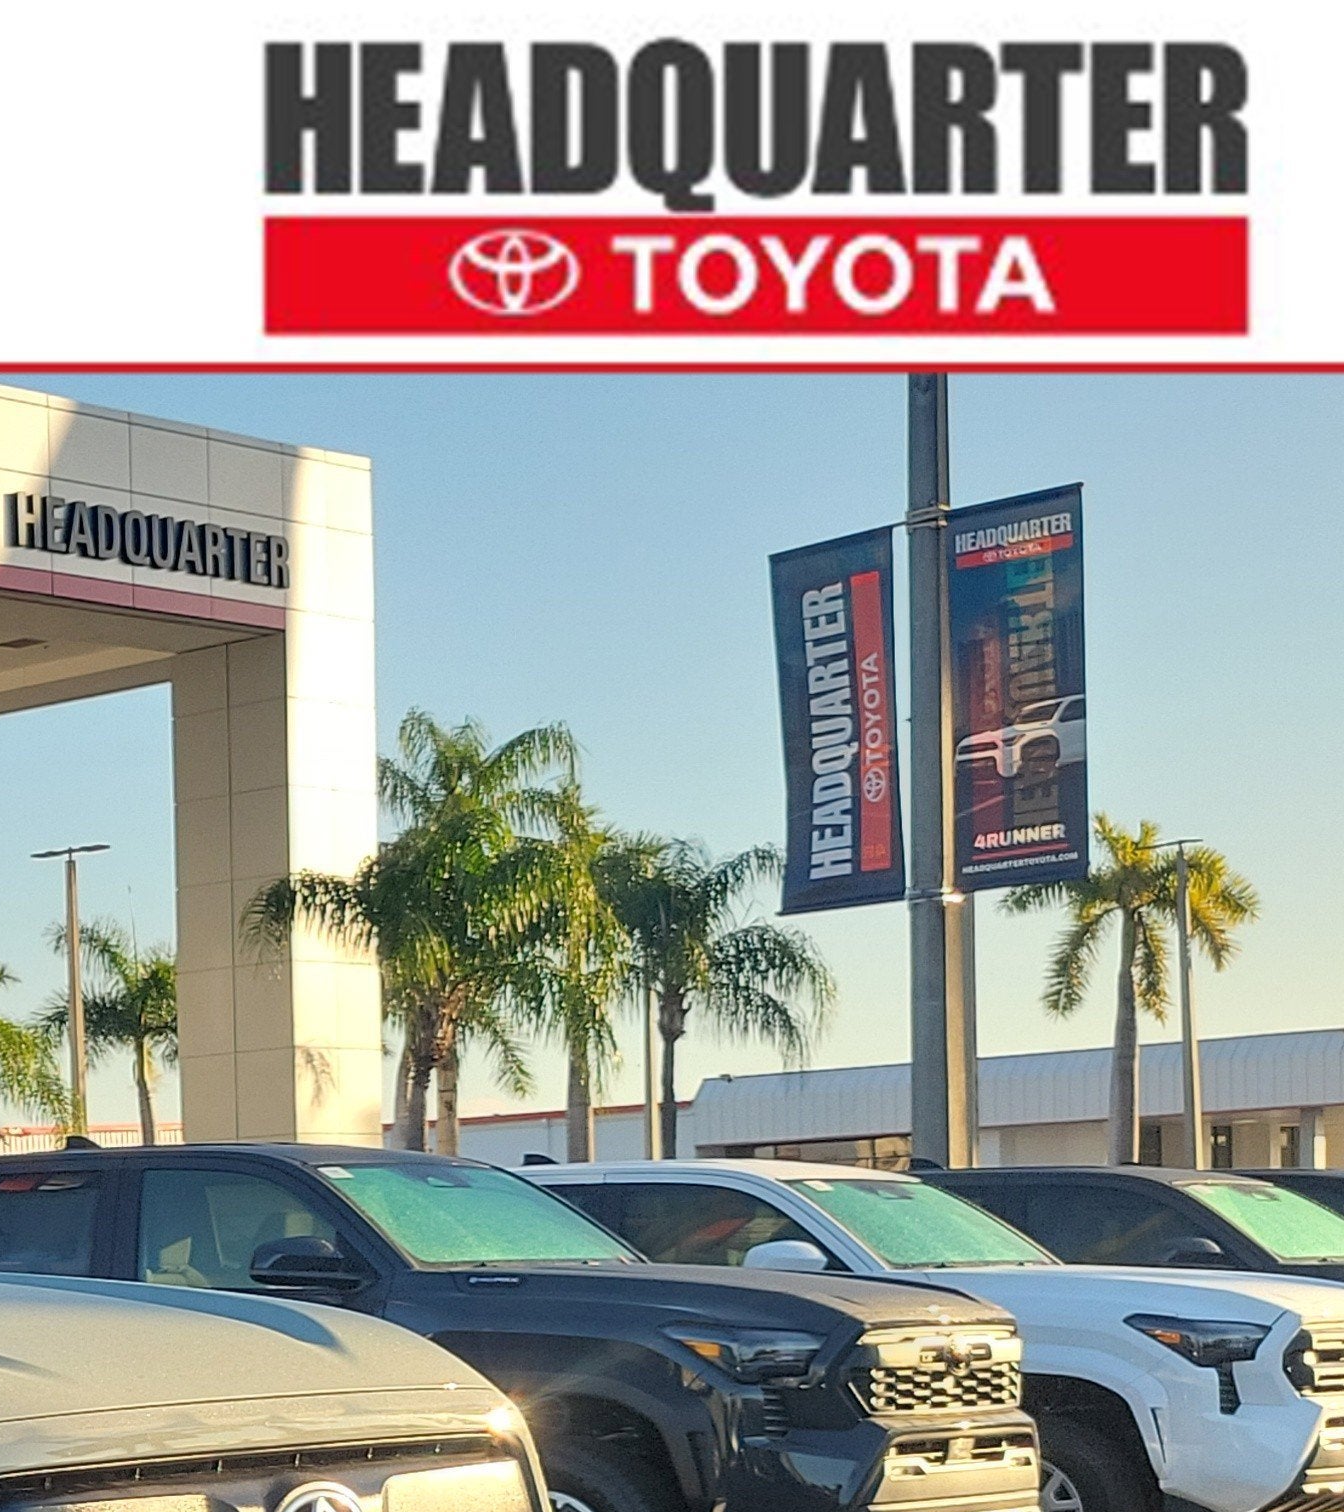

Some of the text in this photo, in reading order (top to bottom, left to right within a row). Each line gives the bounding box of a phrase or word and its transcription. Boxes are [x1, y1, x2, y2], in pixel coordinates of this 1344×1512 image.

[5, 491, 290, 589] HEADQUARTER
[955, 512, 1072, 554] HEADQUARTER
[998, 542, 1042, 559] TOYOTA
[802, 581, 858, 880] HEADQUARTER
[861, 652, 884, 766] TOYOTA
[973, 823, 1067, 850] 4RUNNER
